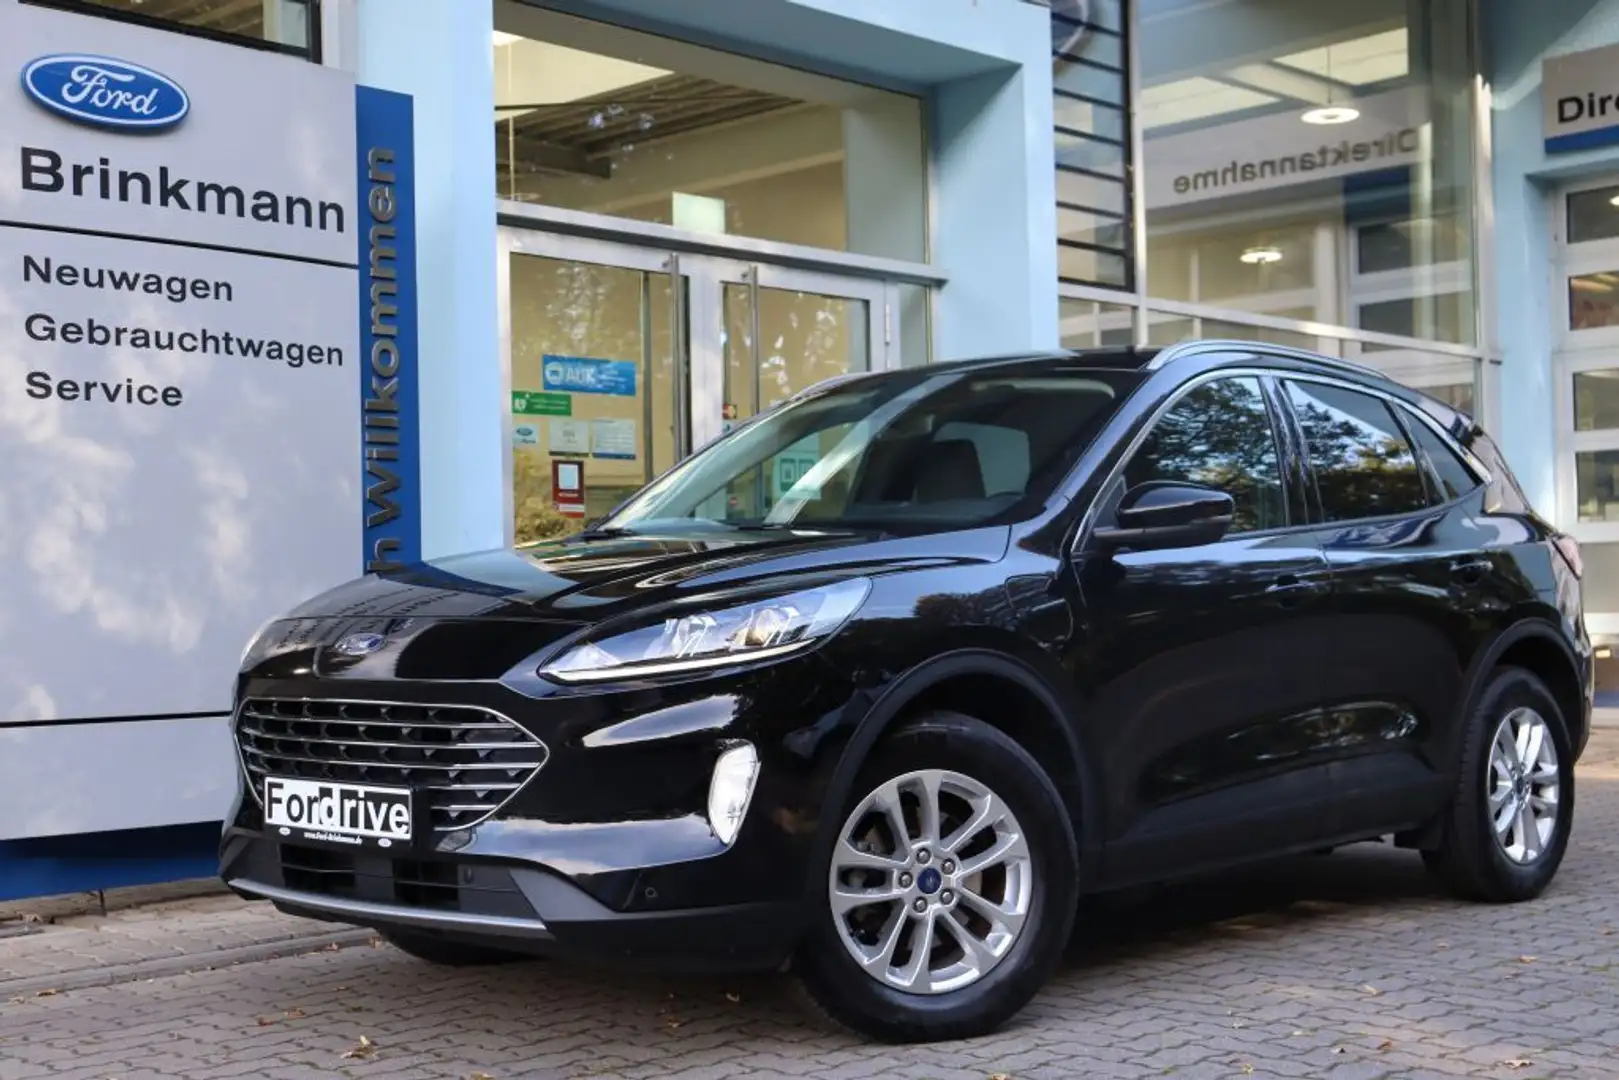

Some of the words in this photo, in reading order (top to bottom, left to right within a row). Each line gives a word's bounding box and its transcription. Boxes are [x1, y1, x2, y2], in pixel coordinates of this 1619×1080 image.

[62, 64, 158, 117] Ford
[20, 146, 345, 233] Brinkmann
[22, 255, 234, 302] Neuwagen
[24, 313, 344, 367] Gebrauchtwagen
[365, 147, 402, 527] Willkommen
[25, 371, 184, 407] Service
[267, 782, 410, 835] Fordrive
